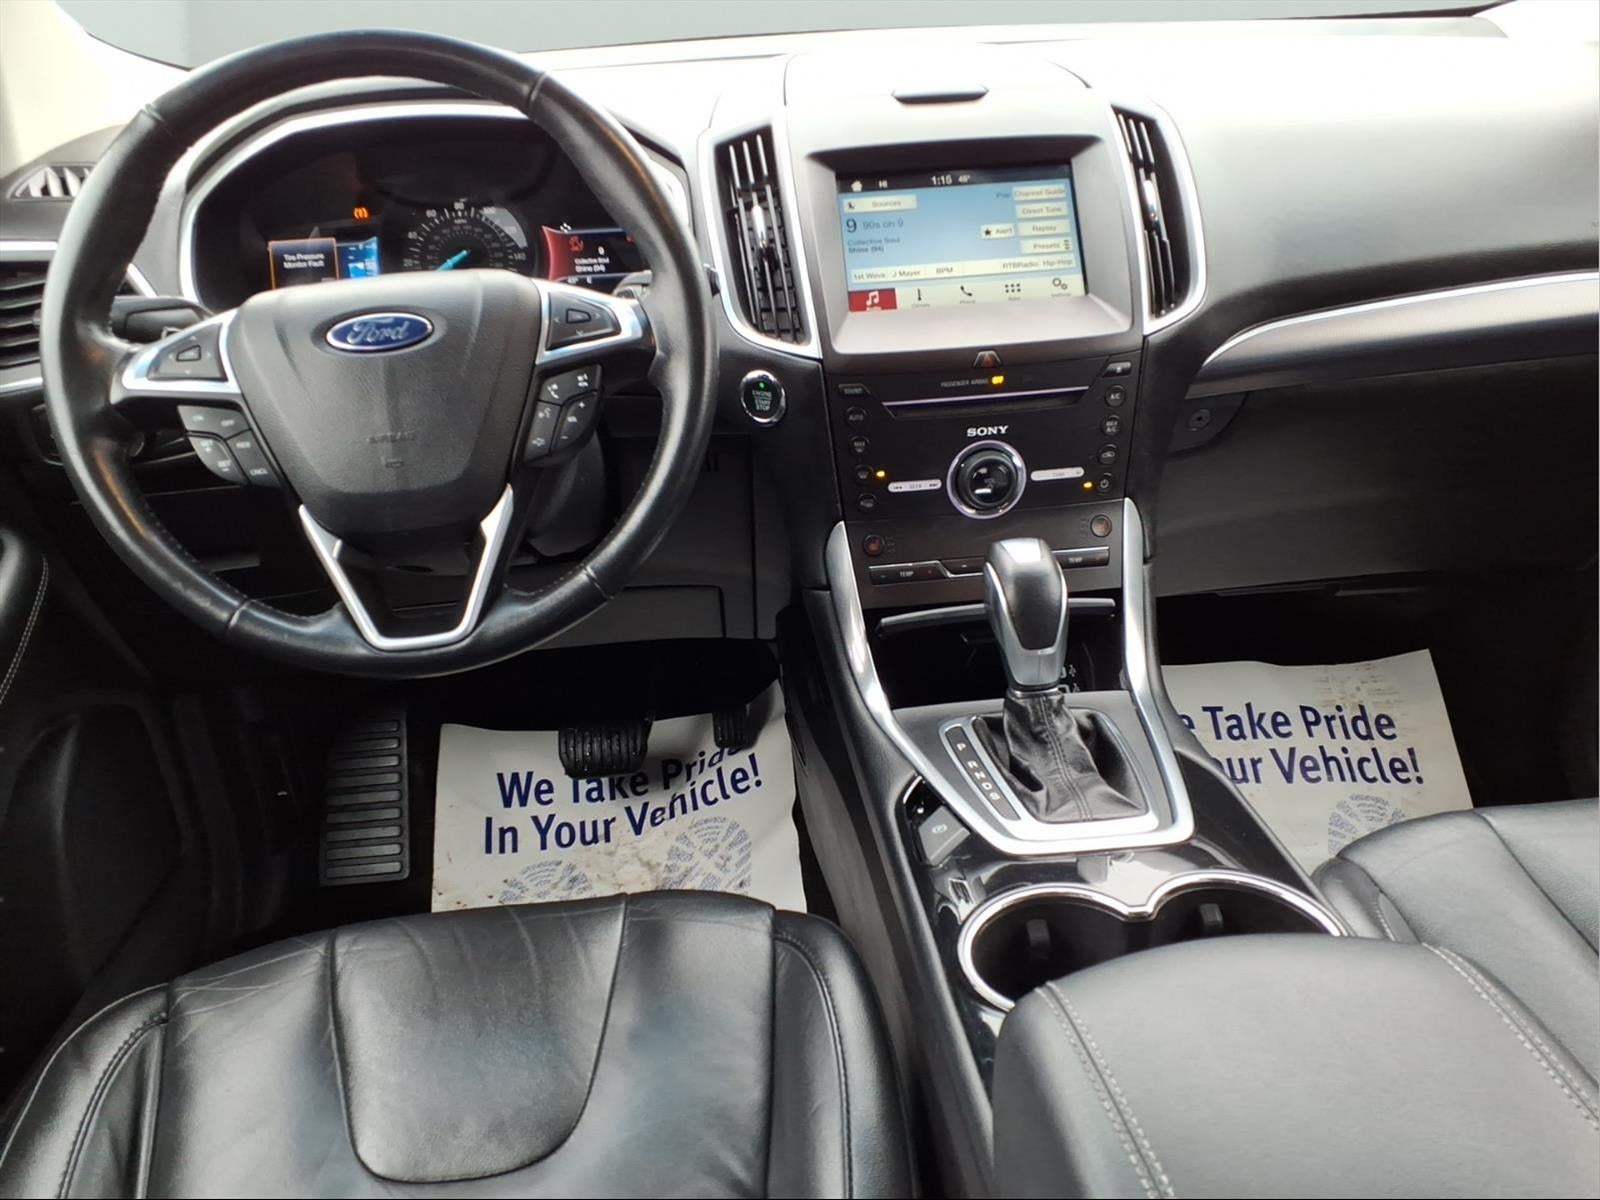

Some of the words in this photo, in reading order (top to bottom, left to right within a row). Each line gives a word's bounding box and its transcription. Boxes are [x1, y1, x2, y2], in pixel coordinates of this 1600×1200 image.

[846, 218, 857, 233] 9
[346, 317, 410, 345] Ford
[967, 425, 1008, 437] SONY
[1202, 702, 1293, 741] Take
[1299, 704, 1398, 741] Pride
[1269, 744, 1424, 785] Vehicle!
[485, 816, 519, 854] In
[531, 813, 617, 850] Your
[624, 752, 762, 836] Vehicle!
[497, 770, 554, 808] We
